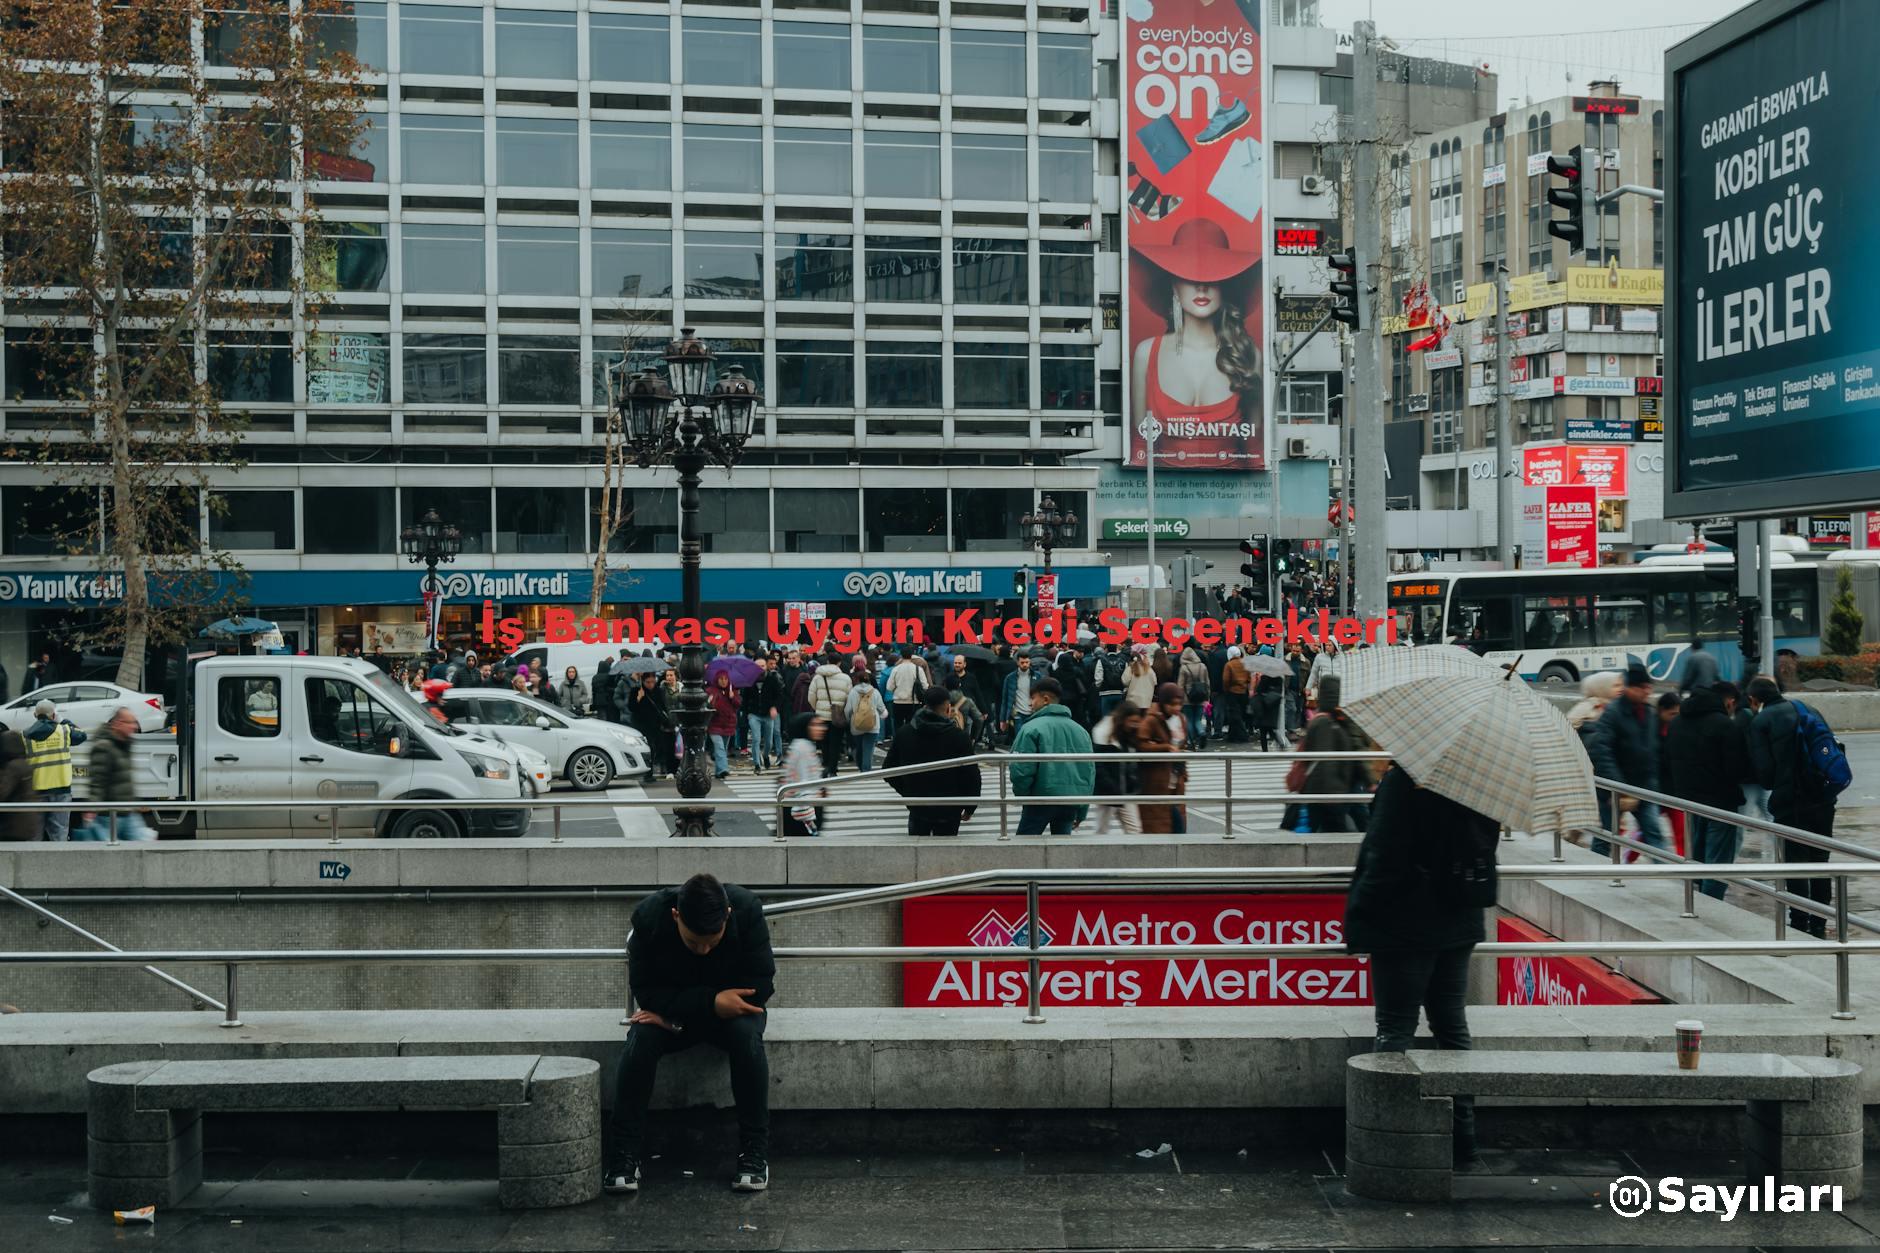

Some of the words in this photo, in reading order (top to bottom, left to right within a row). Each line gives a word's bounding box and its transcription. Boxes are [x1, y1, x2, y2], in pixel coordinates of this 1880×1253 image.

[1139, 24, 1253, 50] everybody's
[1136, 44, 1253, 75] come
[1135, 73, 1219, 119] on
[1702, 96, 1758, 149] GARANTİ
[1761, 71, 1829, 124] BBVA'YLA
[1715, 126, 1810, 200] KOBİ'LER
[1277, 229, 1317, 242] LOVE
[1703, 211, 1756, 274] TAM
[1764, 183, 1824, 254] GÜÇ
[1278, 242, 1318, 254] SHOP
[1575, 273, 1605, 289] CITI
[1697, 267, 1832, 362] İLERLER
[1569, 377, 1630, 391] gezinomi
[1782, 376, 1812, 394] Finansal
[1812, 372, 1837, 390] Sağlık
[1844, 366, 1873, 384] Girişim
[1692, 398, 1713, 411] Uzman
[1744, 388, 1757, 402] Tek
[1757, 385, 1776, 400] Ekran
[1167, 422, 1256, 440] NİŞANTAŞI
[1549, 502, 1592, 513] ZAFER
[18, 574, 123, 603] YapıKredi
[471, 572, 569, 599] YapıKredi
[892, 571, 931, 596] Yapı
[932, 570, 982, 593] Kredi
[322, 863, 345, 877] WC
[1071, 910, 1196, 946] Metro
[928, 959, 1140, 1007] Alışveriş
[1160, 957, 1369, 1000] Merkezi
[1539, 958, 1573, 1006] Metro
